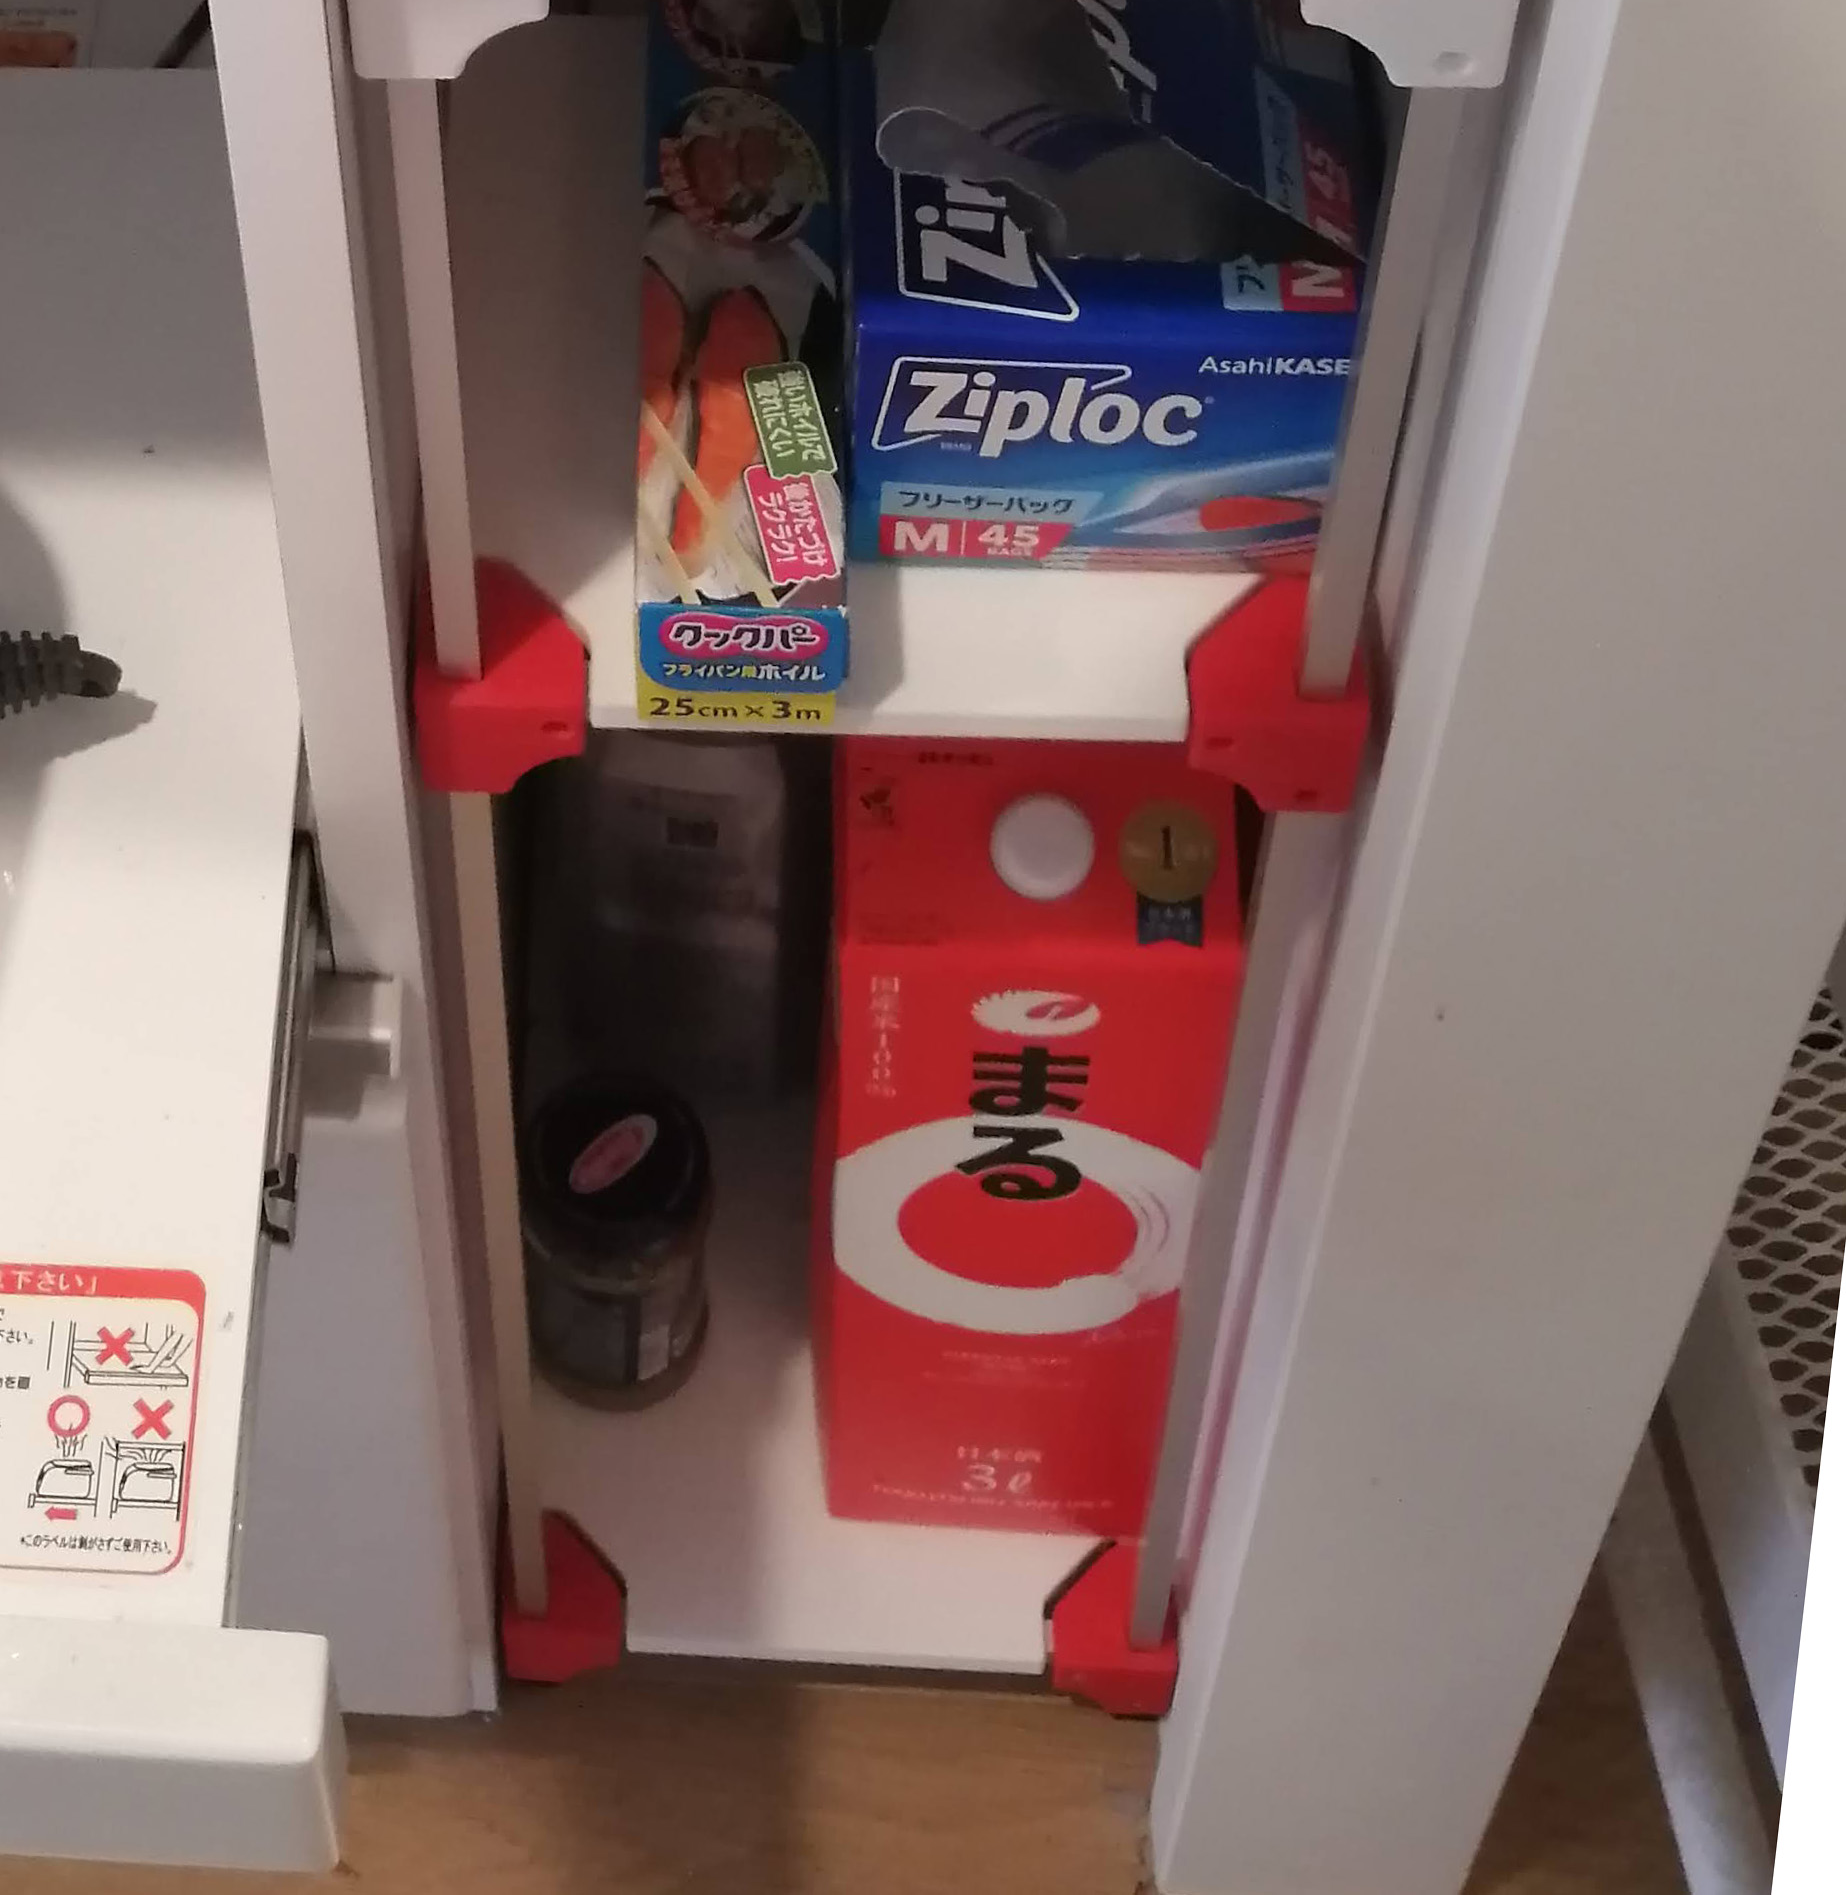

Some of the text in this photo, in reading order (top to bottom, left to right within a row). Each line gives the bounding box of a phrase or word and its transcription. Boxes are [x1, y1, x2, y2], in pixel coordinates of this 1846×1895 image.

[1200, 355, 1350, 376] AsahiKASE
[903, 370, 1203, 458] Ziploc
[898, 490, 1075, 515] フリーザーバッグ
[893, 520, 1041, 553] M 45
[671, 622, 819, 650] クックパー
[955, 1046, 1090, 1201] まる
[0, 1270, 97, 1295] 下さい」
